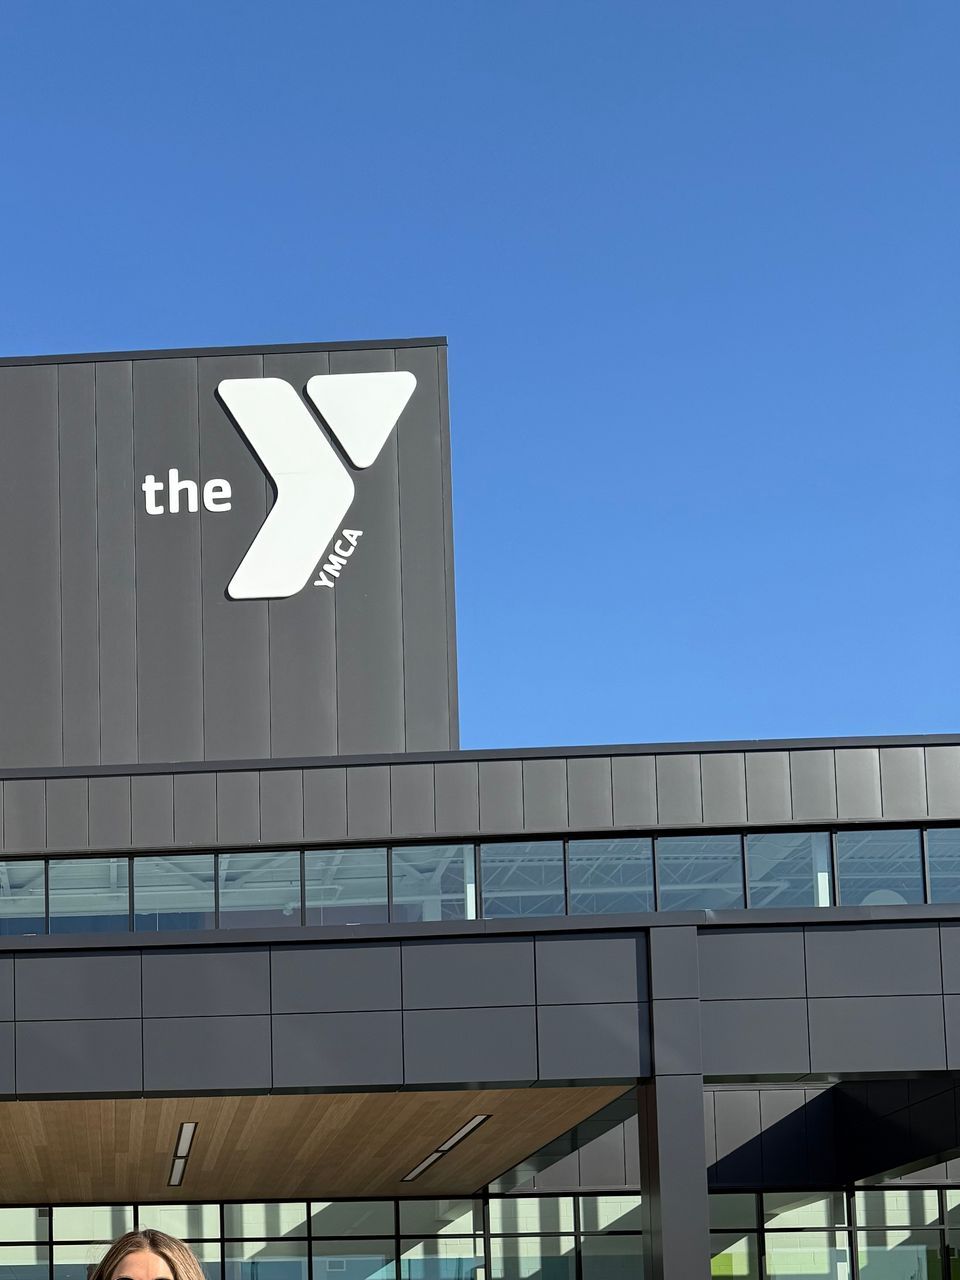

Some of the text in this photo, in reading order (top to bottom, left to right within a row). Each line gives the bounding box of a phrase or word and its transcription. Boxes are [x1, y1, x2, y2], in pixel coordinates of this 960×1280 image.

[141, 370, 418, 599] the Y
[313, 528, 364, 589] YMCA
